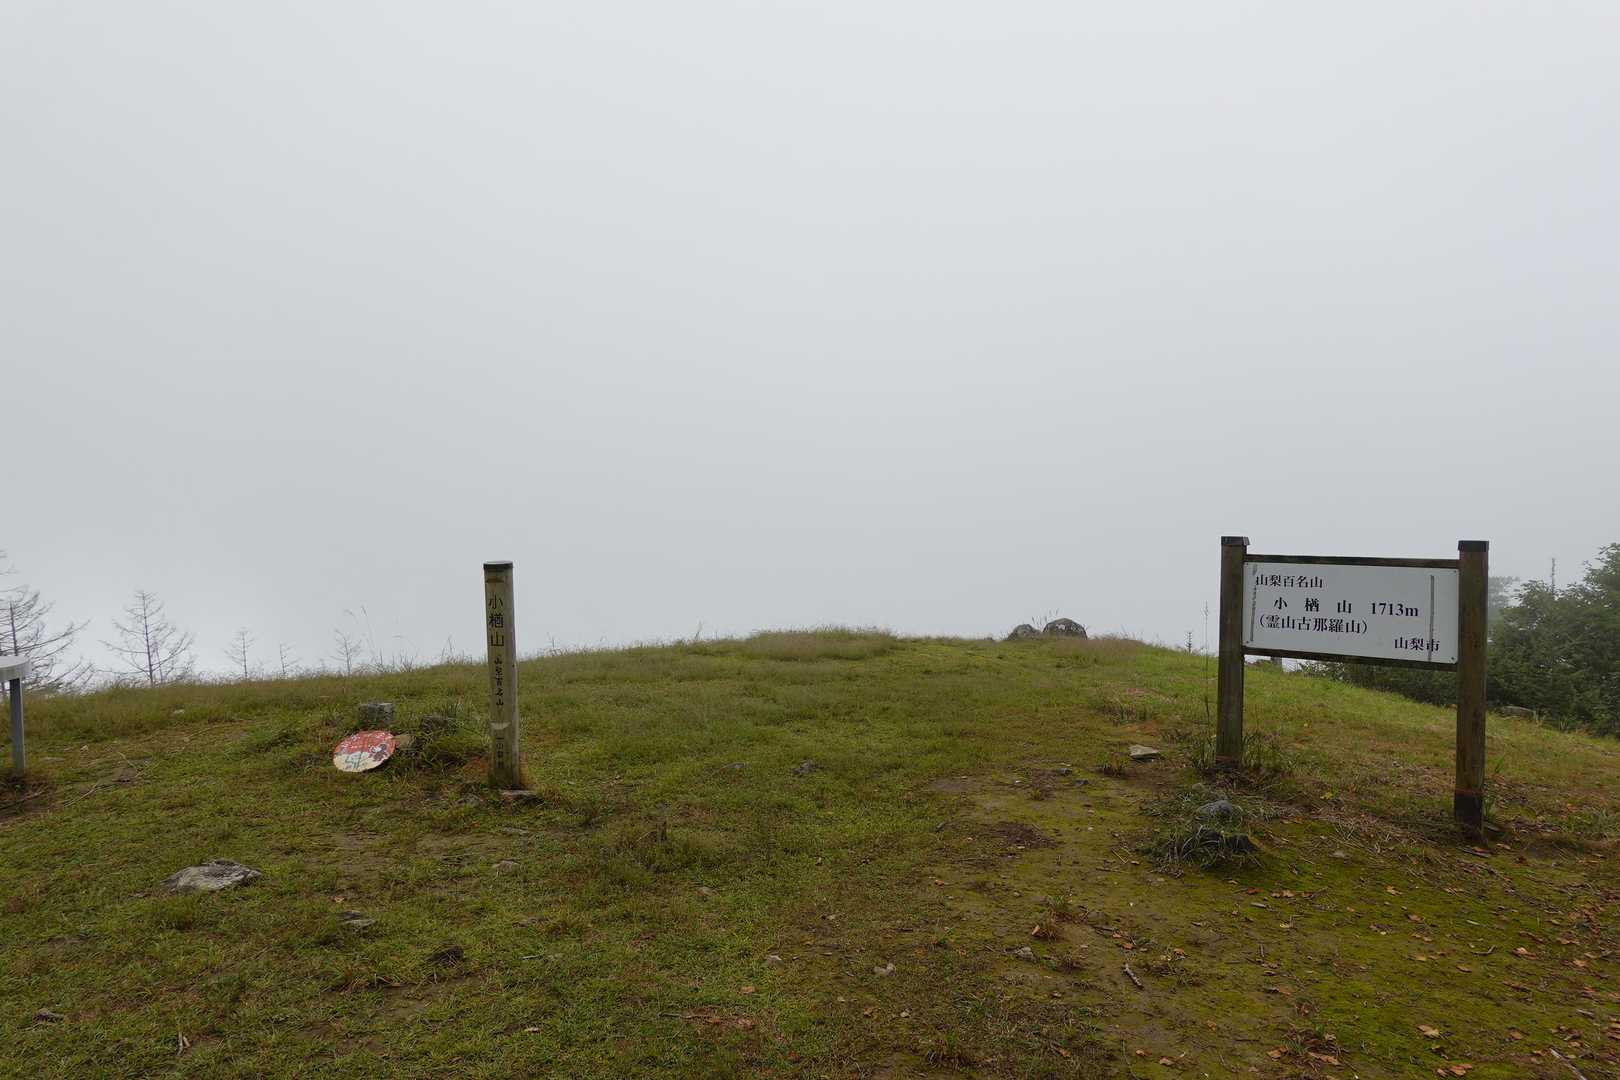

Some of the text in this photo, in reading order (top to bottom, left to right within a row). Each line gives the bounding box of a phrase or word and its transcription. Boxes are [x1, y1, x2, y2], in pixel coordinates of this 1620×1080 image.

[1256, 574, 1323, 589] 山梨百名山
[1371, 602, 1419, 617] 1713m
[1394, 636, 1441, 652] 山梨市
